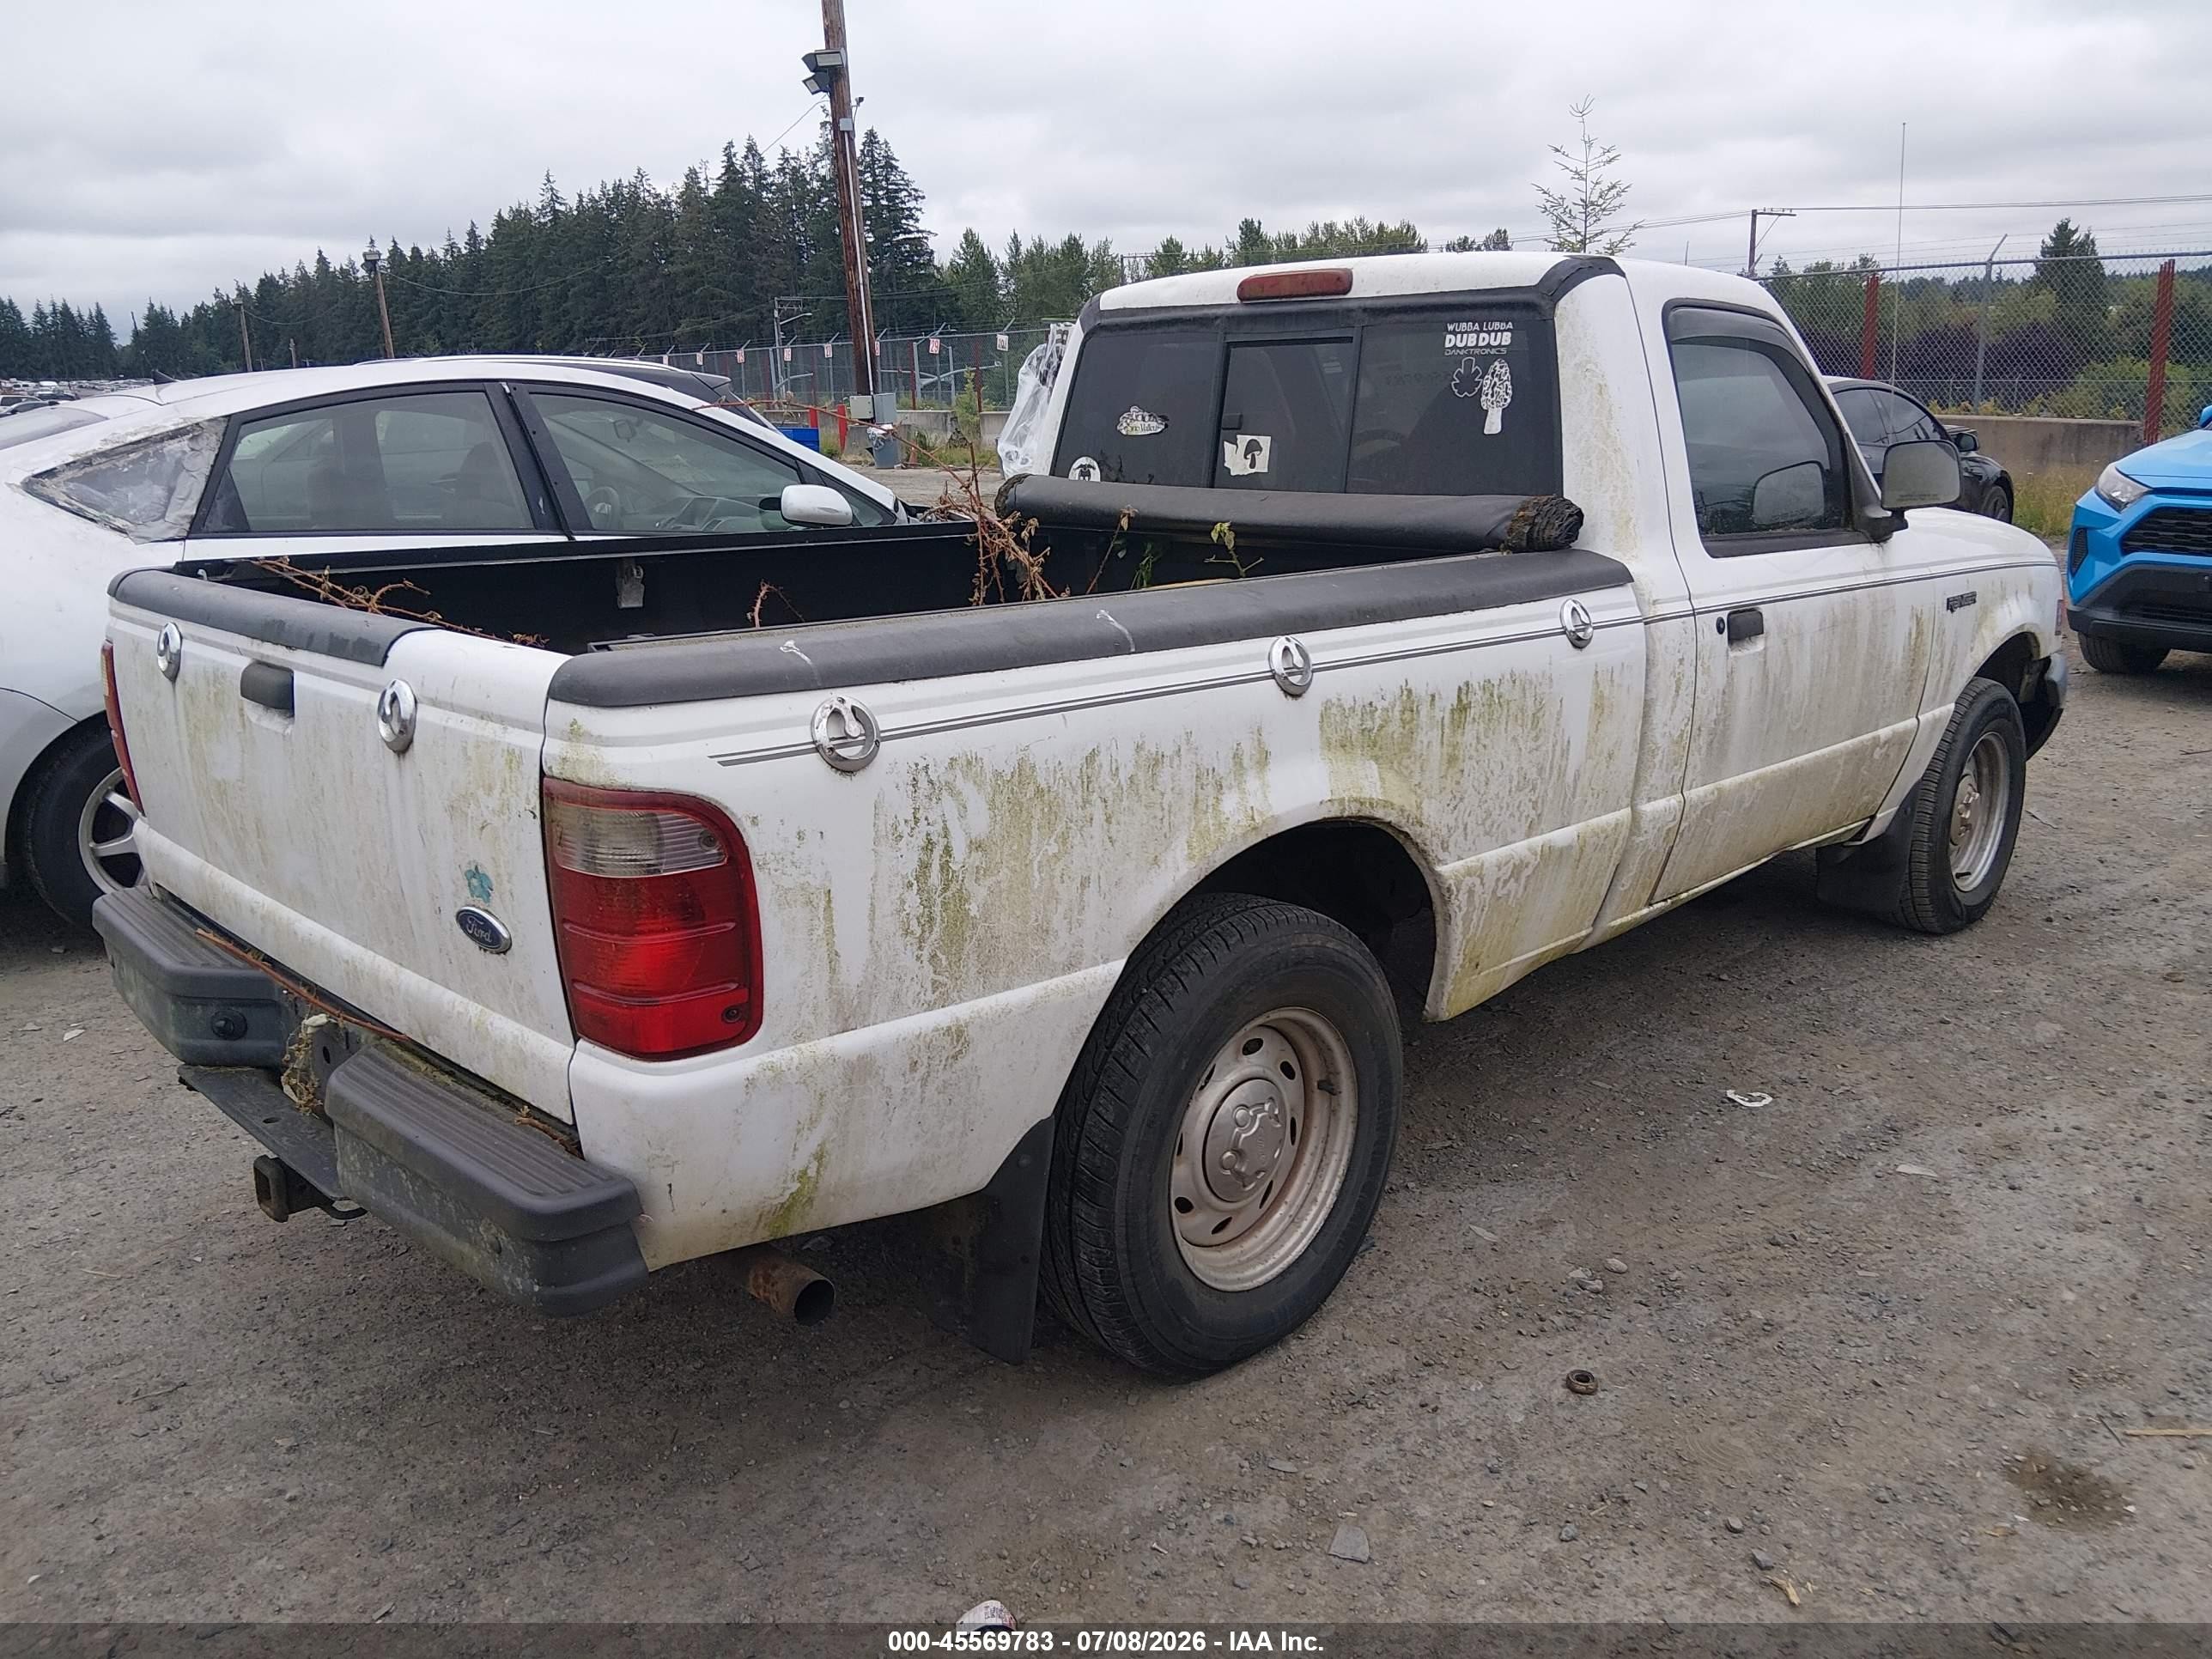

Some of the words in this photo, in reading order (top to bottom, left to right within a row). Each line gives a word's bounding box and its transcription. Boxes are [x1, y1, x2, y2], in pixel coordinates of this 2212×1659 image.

[1447, 322, 1480, 332] WUBBA
[1483, 321, 1514, 331] LUBBA
[930, 339, 939, 353] 29
[466, 915, 492, 943] Ford
